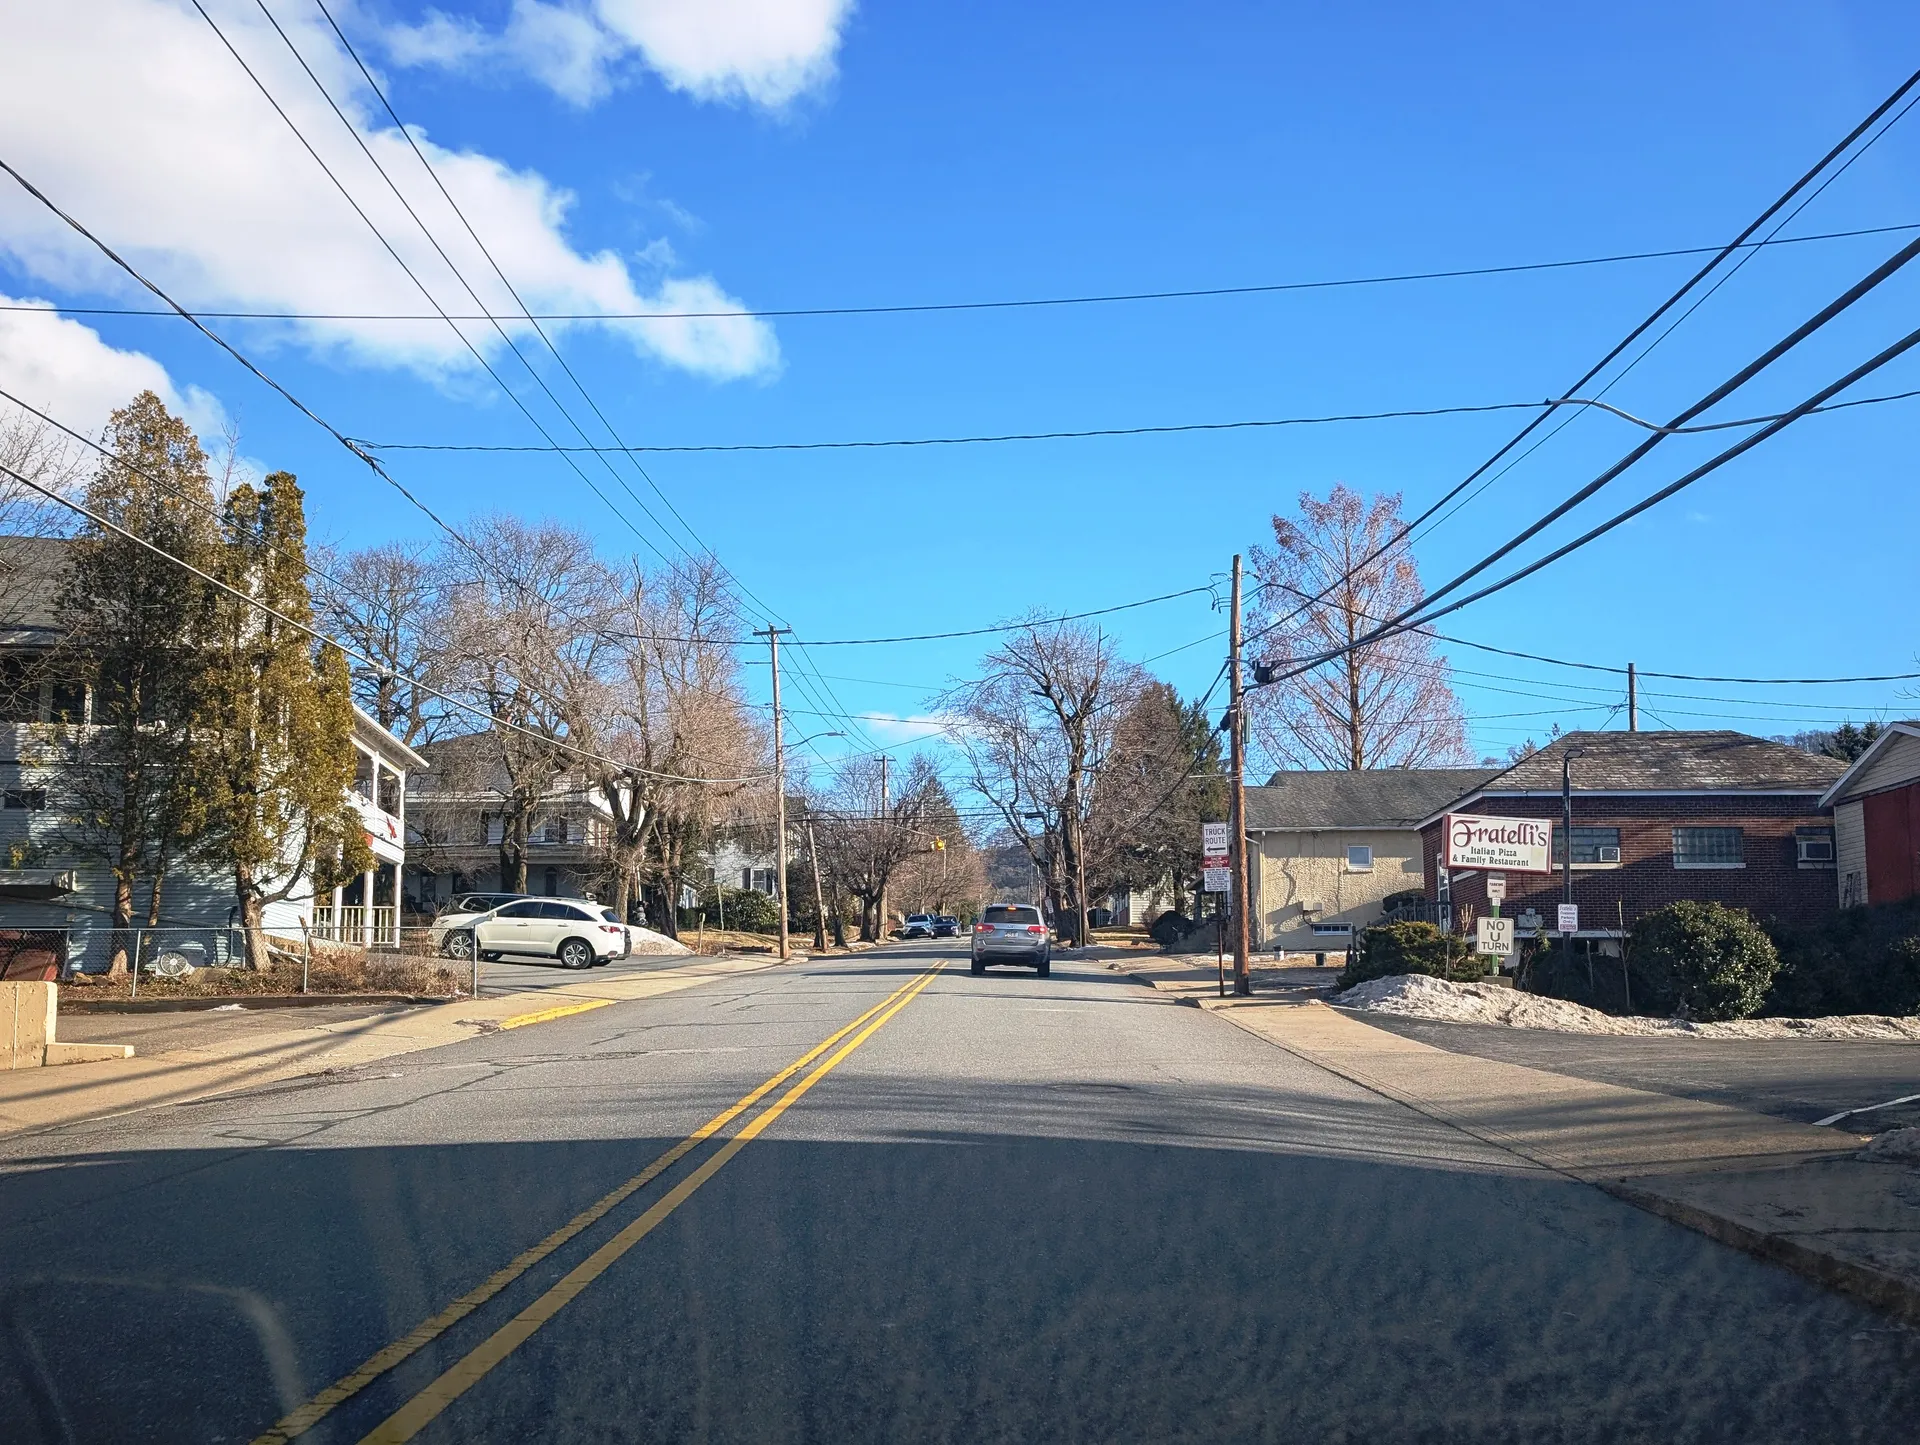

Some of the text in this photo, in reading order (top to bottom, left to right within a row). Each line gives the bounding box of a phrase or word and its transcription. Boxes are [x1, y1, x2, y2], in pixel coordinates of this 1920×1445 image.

[1205, 828, 1225, 836] TRUCK
[1452, 819, 1547, 848] Fratelli's
[1470, 846, 1517, 857] Italian Pizza
[1461, 855, 1486, 866] Family
[1489, 856, 1529, 867] Restaurant
[1486, 921, 1505, 931] NO
[1490, 932, 1501, 942] U
[1481, 941, 1509, 951] TURN
